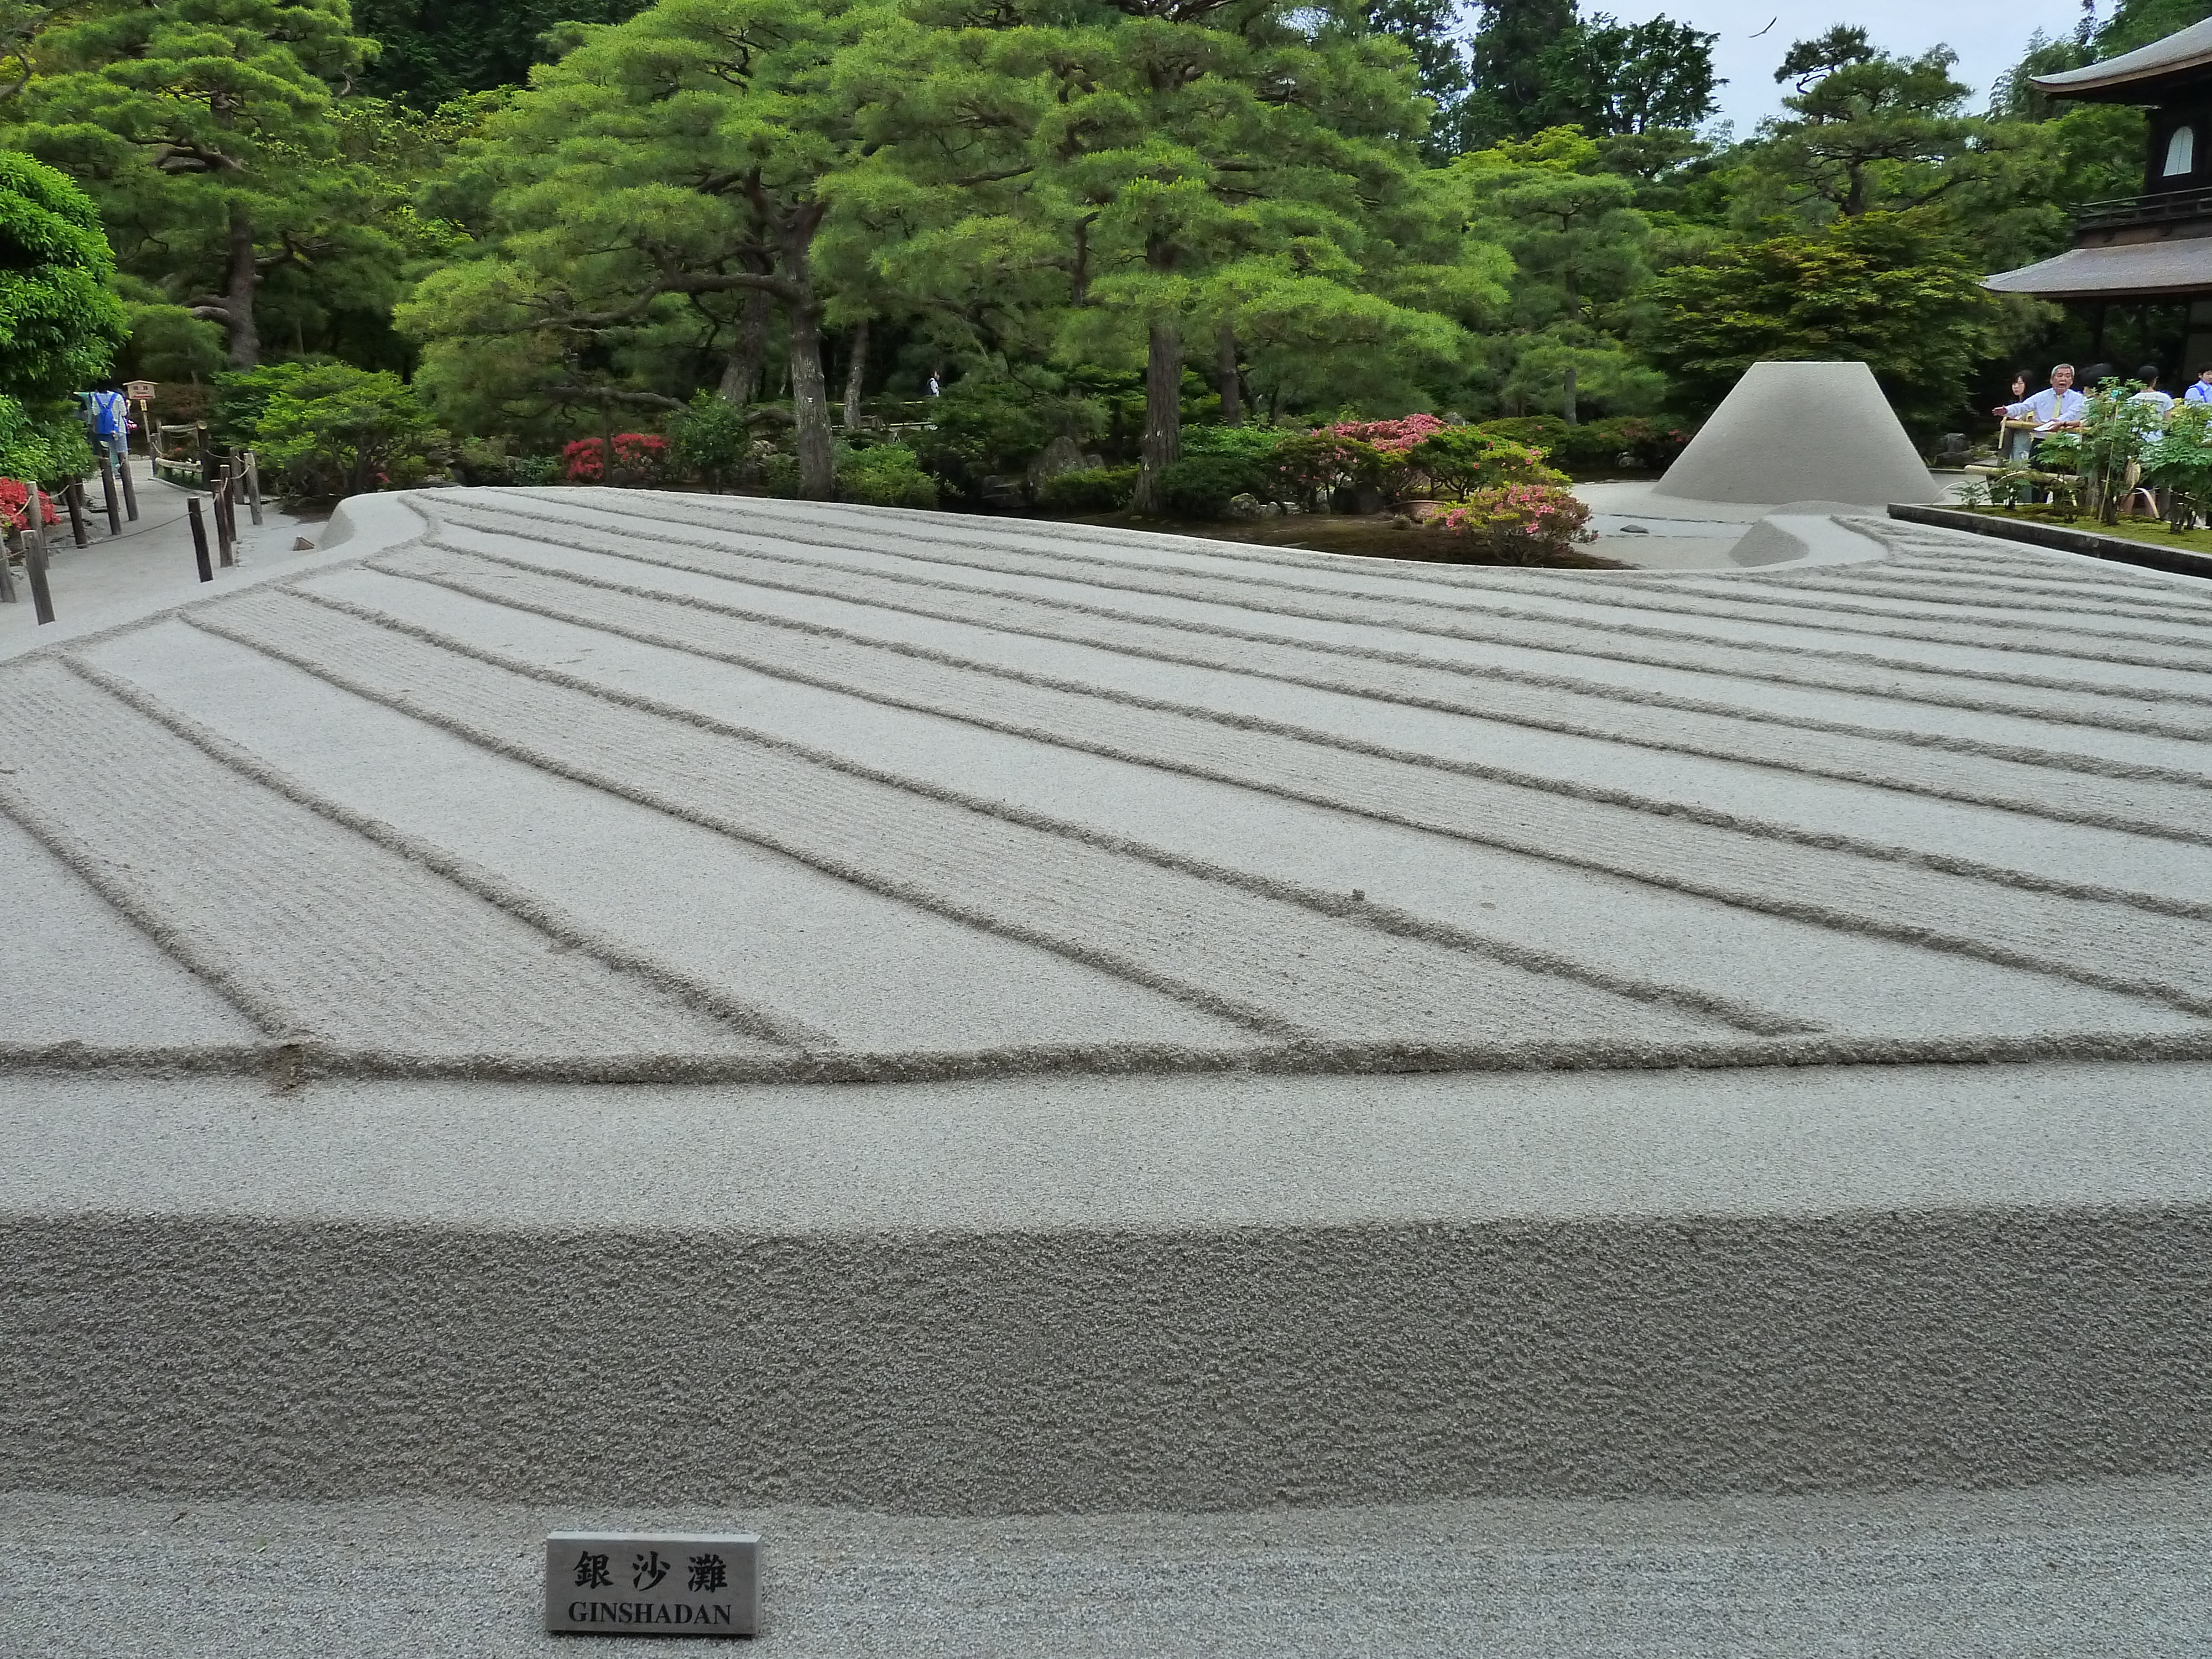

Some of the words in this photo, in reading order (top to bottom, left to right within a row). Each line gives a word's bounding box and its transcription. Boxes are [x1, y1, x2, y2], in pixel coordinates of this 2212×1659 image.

[572, 1550, 728, 1593] 銀沙灘
[568, 1601, 732, 1625] GINSHADAN
